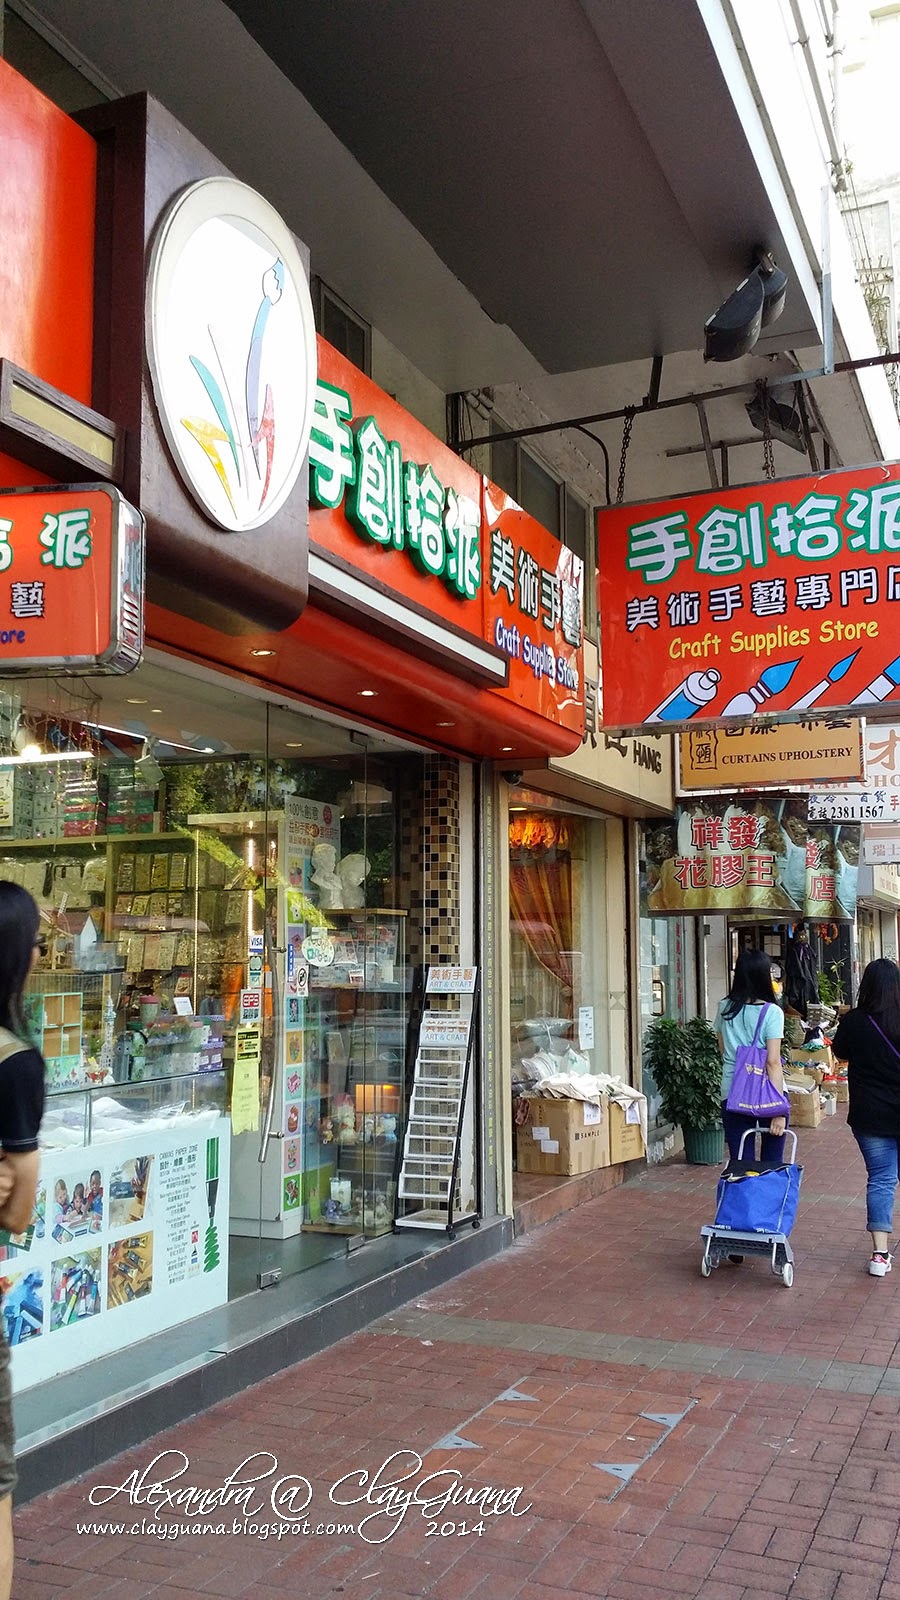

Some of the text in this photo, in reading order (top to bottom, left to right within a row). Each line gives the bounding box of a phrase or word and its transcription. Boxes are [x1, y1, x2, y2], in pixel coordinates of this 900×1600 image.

[308, 380, 482, 600] 手創拾派
[627, 481, 900, 585] 手創拾派
[10, 581, 45, 619] 藝
[490, 530, 582, 649] 美術手藝
[494, 617, 521, 660] Craft
[556, 657, 580, 692] Store
[669, 619, 880, 660] Craft Supplies Store
[632, 739, 662, 774] HANG
[721, 747, 853, 766] CURTAINS UPHOLSTERY
[808, 805, 884, 820] 電話 2381 1567
[691, 814, 761, 850] 祥發
[674, 854, 777, 890] 花膠王
[810, 871, 836, 902] 店
[431, 969, 473, 980] 美術手藝
[450, 980, 472, 988] CRAFT
[243, 994, 259, 1007] EPS
[446, 1033, 467, 1041] CRAFT
